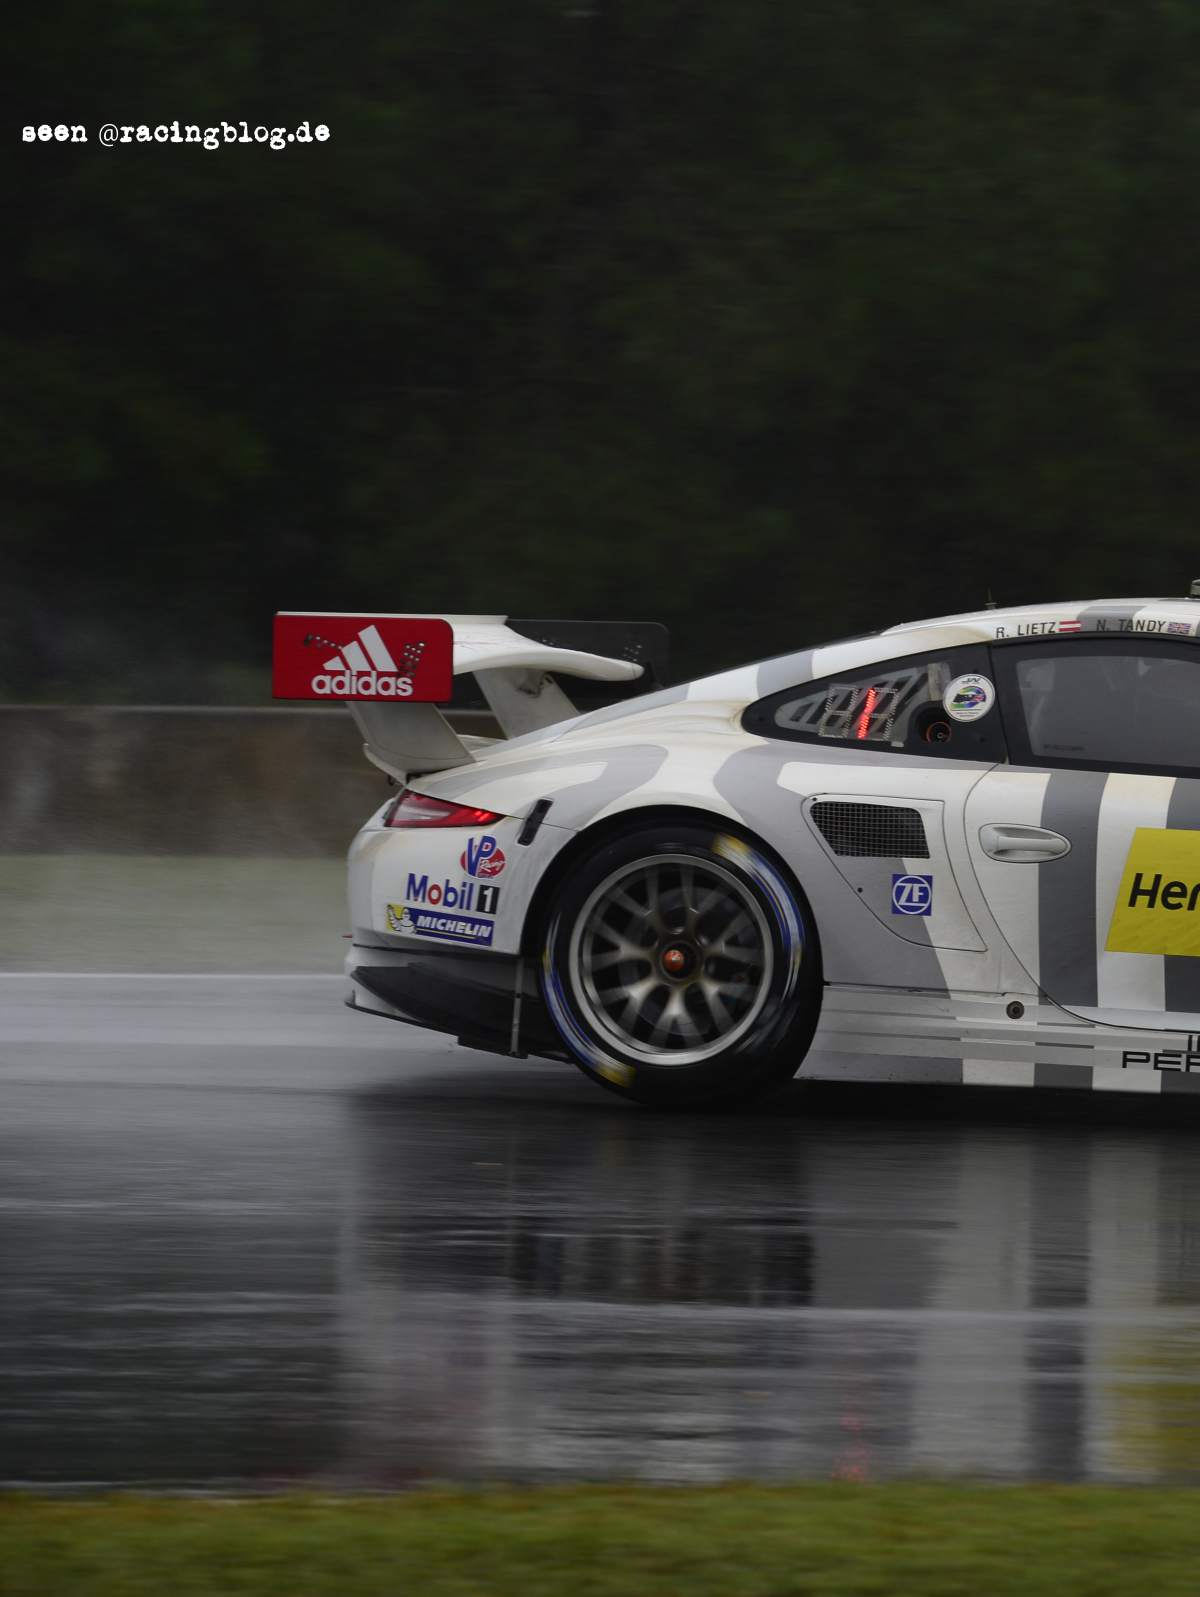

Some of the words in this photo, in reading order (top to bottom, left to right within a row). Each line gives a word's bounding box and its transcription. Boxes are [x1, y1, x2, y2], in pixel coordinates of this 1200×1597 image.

[995, 626, 1010, 639] R.
[1017, 621, 1057, 636] LIETZ
[1096, 619, 1110, 632] N.
[1119, 619, 1169, 632] TANDY
[311, 669, 414, 697] adidas
[467, 835, 497, 877] VP
[406, 872, 475, 911] Mobil
[416, 915, 492, 938] MICHELIN
